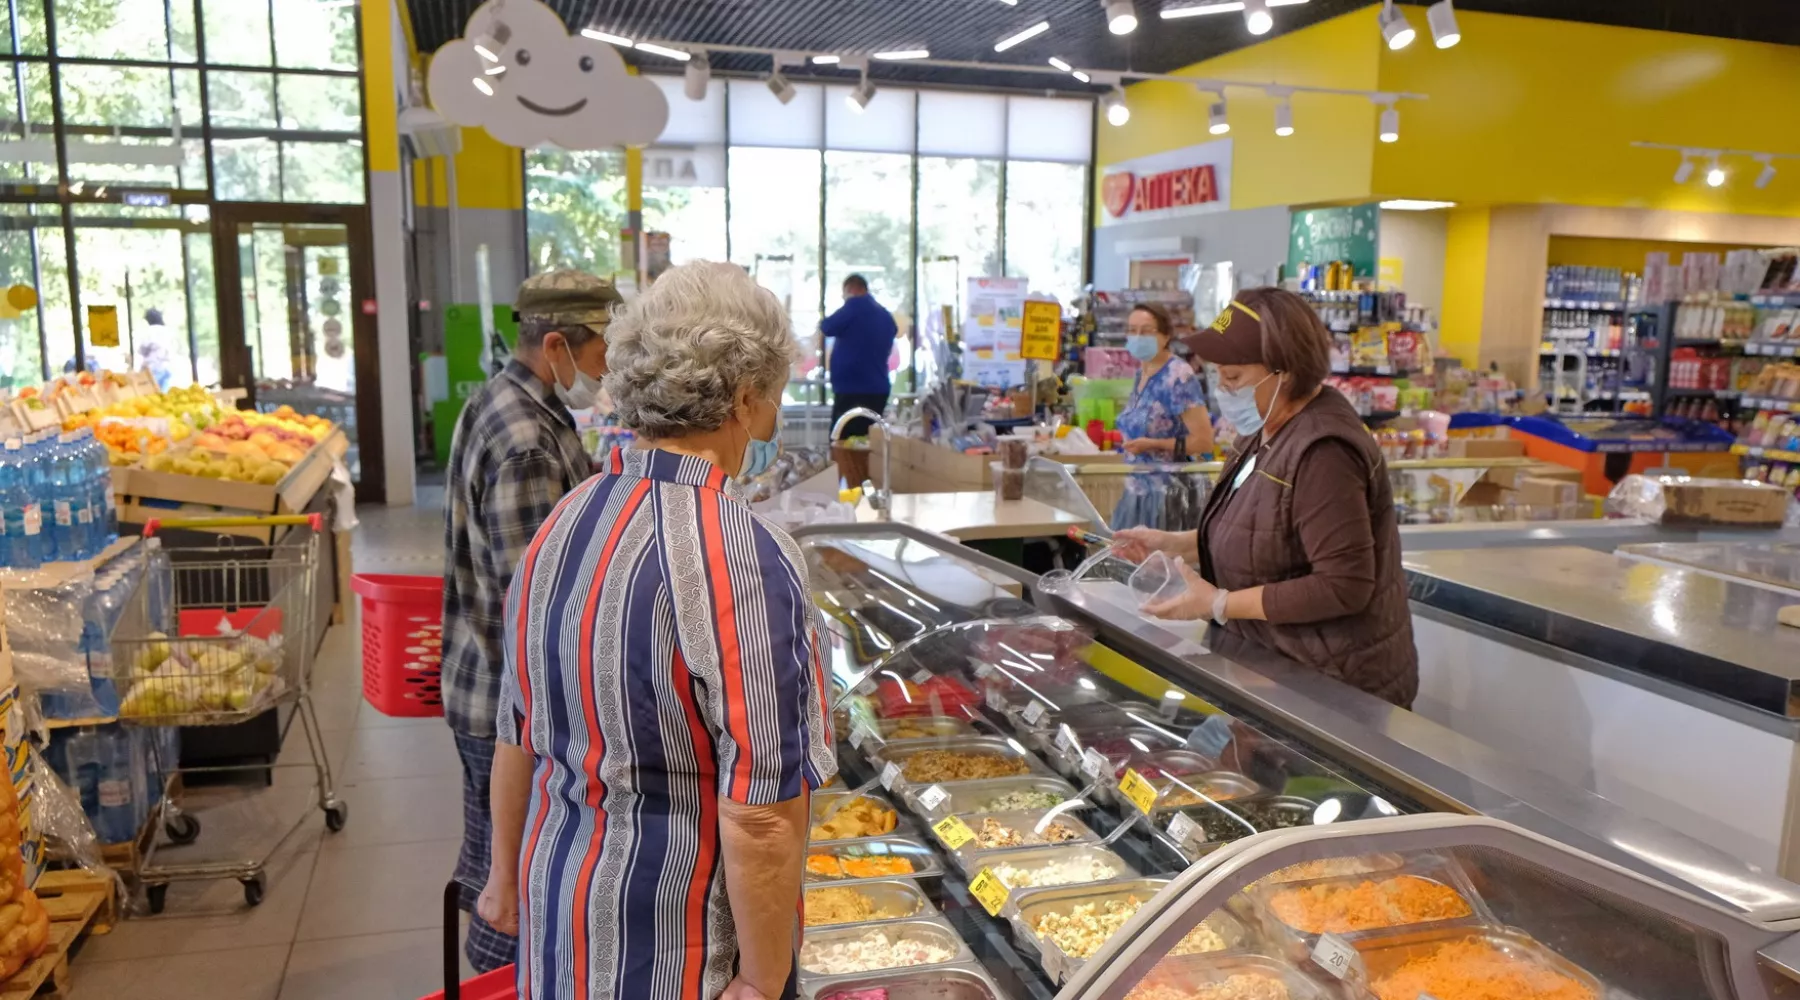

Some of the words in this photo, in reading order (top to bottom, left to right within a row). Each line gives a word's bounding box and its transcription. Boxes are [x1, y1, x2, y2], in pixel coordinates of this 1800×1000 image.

[1133, 164, 1219, 212] АПТЕКА
[990, 895, 1002, 909] 22
[1329, 952, 1344, 966] 20
